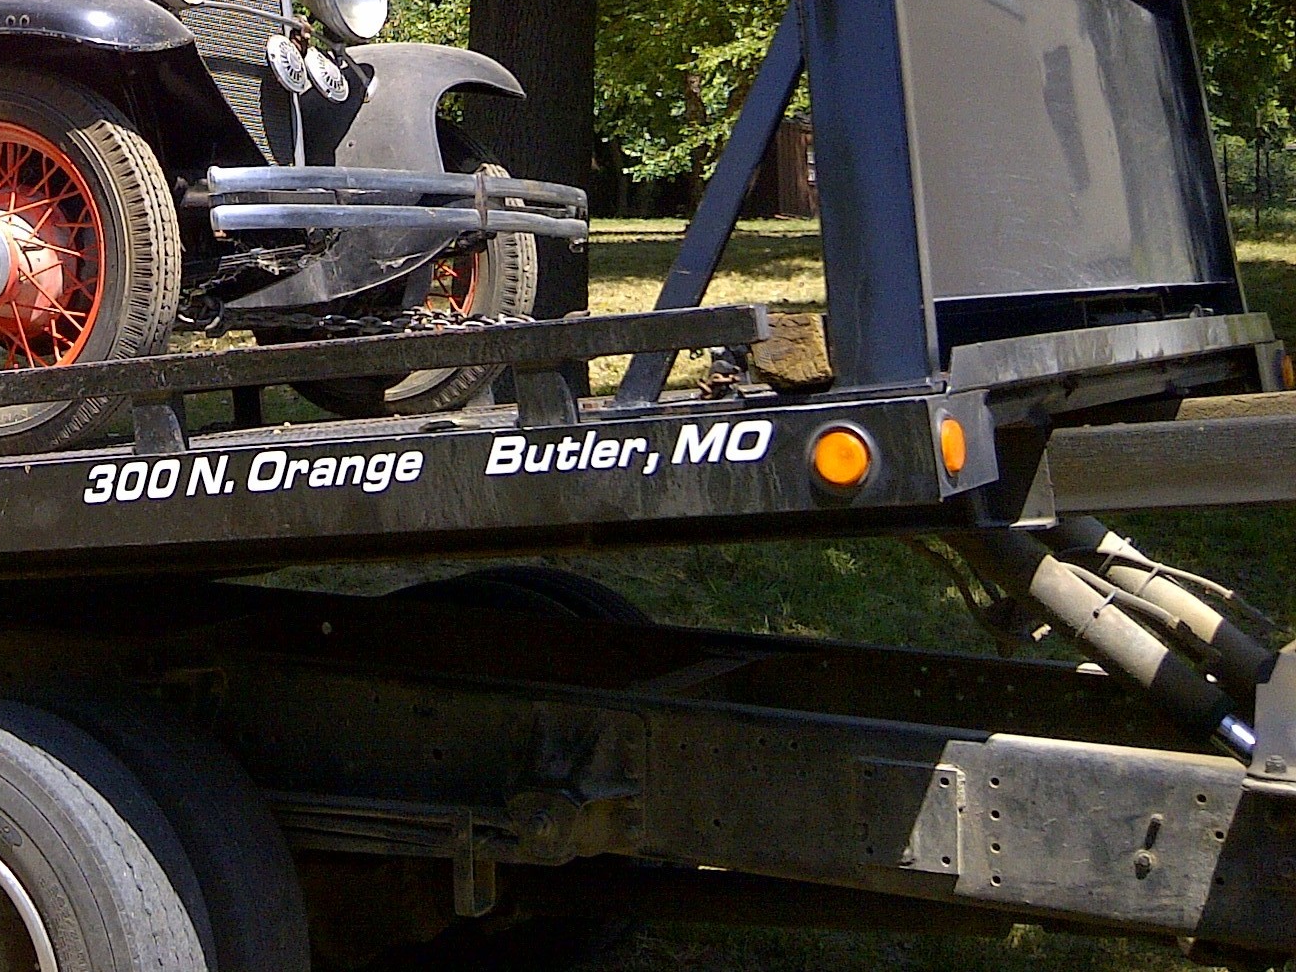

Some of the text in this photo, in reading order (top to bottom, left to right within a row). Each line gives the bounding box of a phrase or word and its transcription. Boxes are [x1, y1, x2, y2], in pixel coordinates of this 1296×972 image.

[484, 420, 773, 475] Butler, MO
[83, 450, 424, 504] 300 N. Orange
